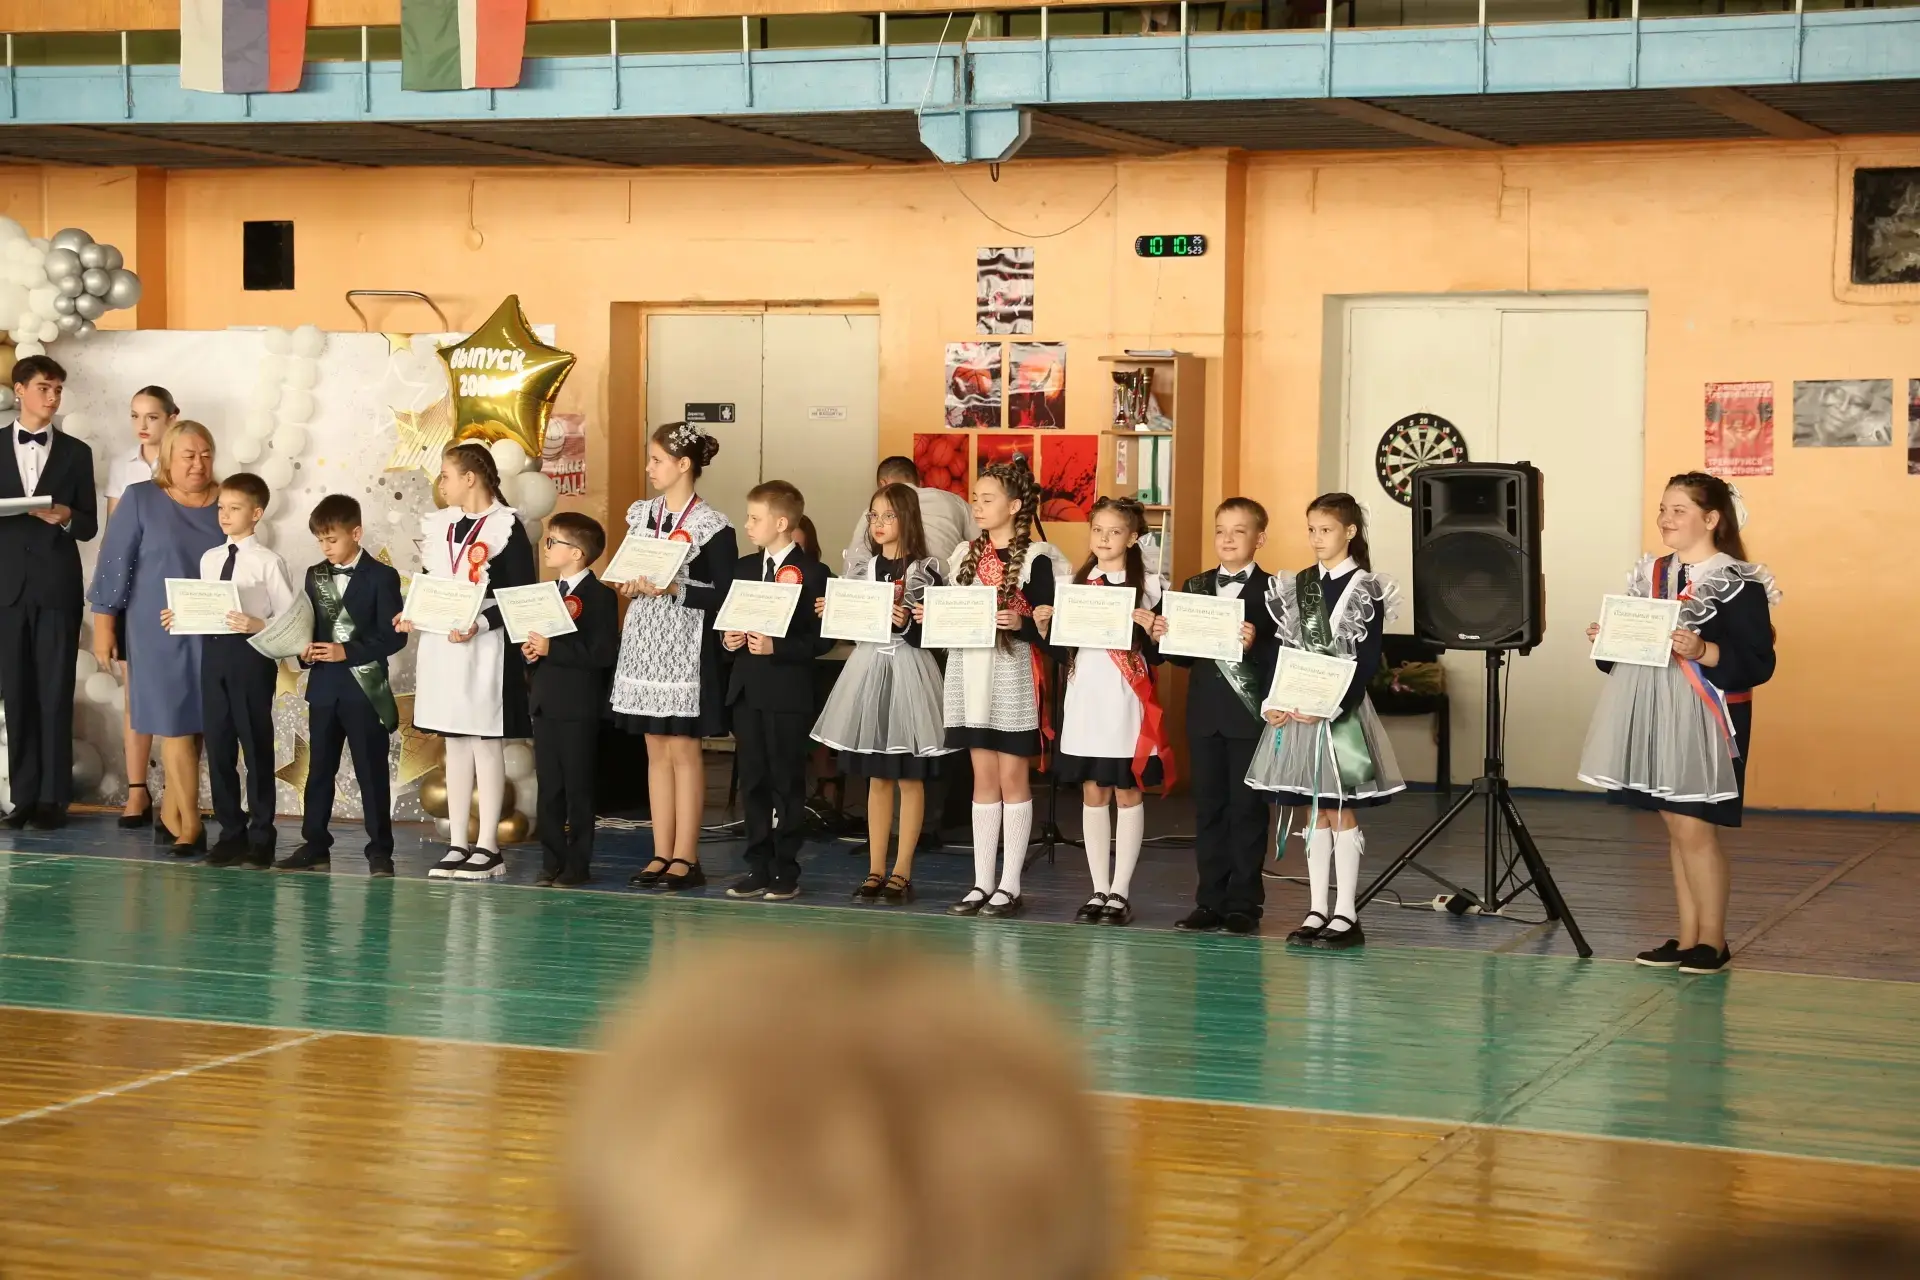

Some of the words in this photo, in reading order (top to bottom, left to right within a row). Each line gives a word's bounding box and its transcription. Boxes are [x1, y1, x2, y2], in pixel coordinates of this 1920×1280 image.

[1150, 236, 1163, 255] 10
[1174, 236, 1187, 255] 10
[450, 346, 526, 373] ВЫПУСК
[1419, 417, 1428, 425] 20
